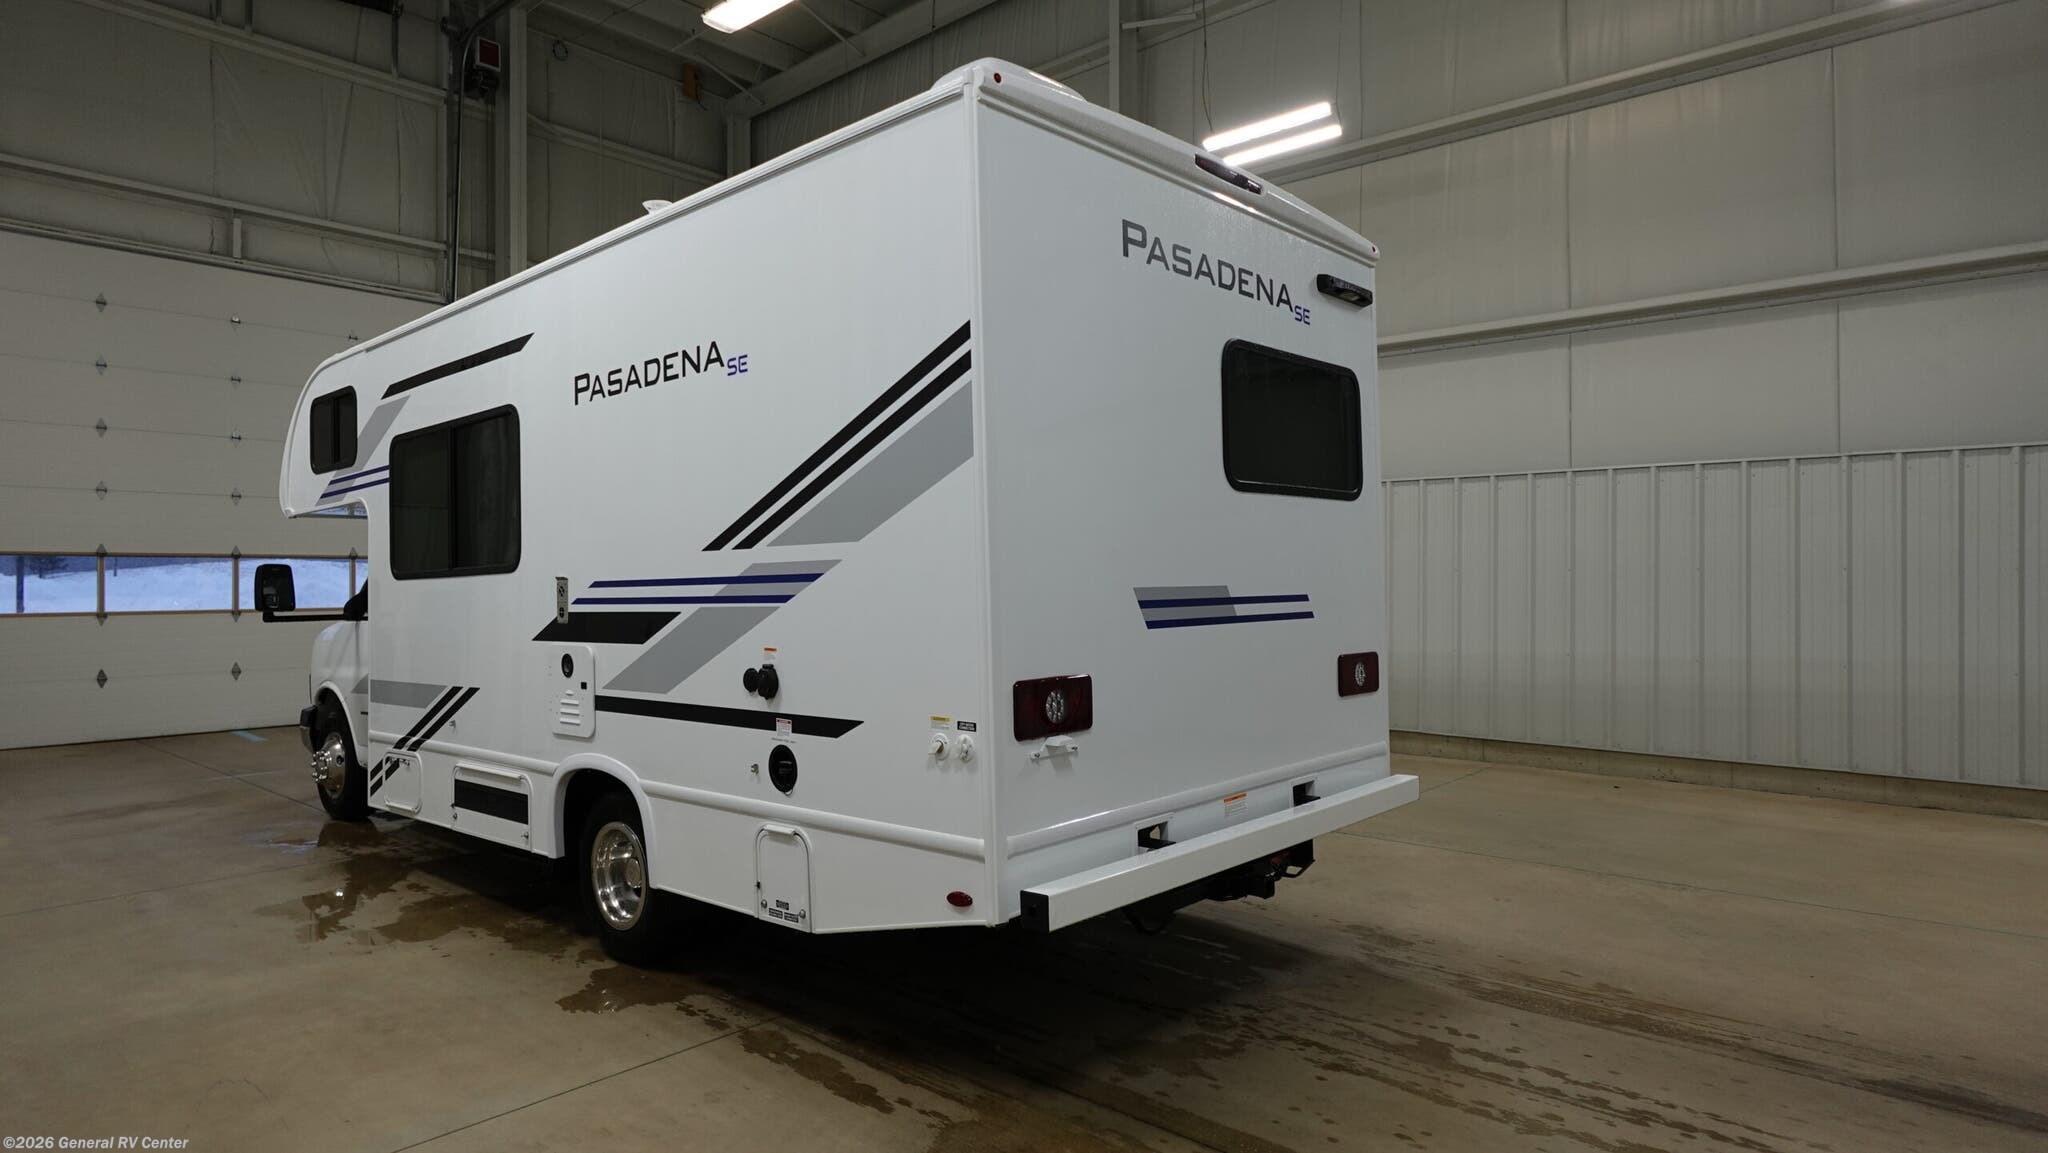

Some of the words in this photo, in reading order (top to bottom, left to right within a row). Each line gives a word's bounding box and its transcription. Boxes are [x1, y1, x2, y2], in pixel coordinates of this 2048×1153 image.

[1122, 219, 1293, 313] PASADENA
[1294, 305, 1311, 325] SE
[575, 341, 725, 406] PASADENA
[727, 354, 748, 376] SE
